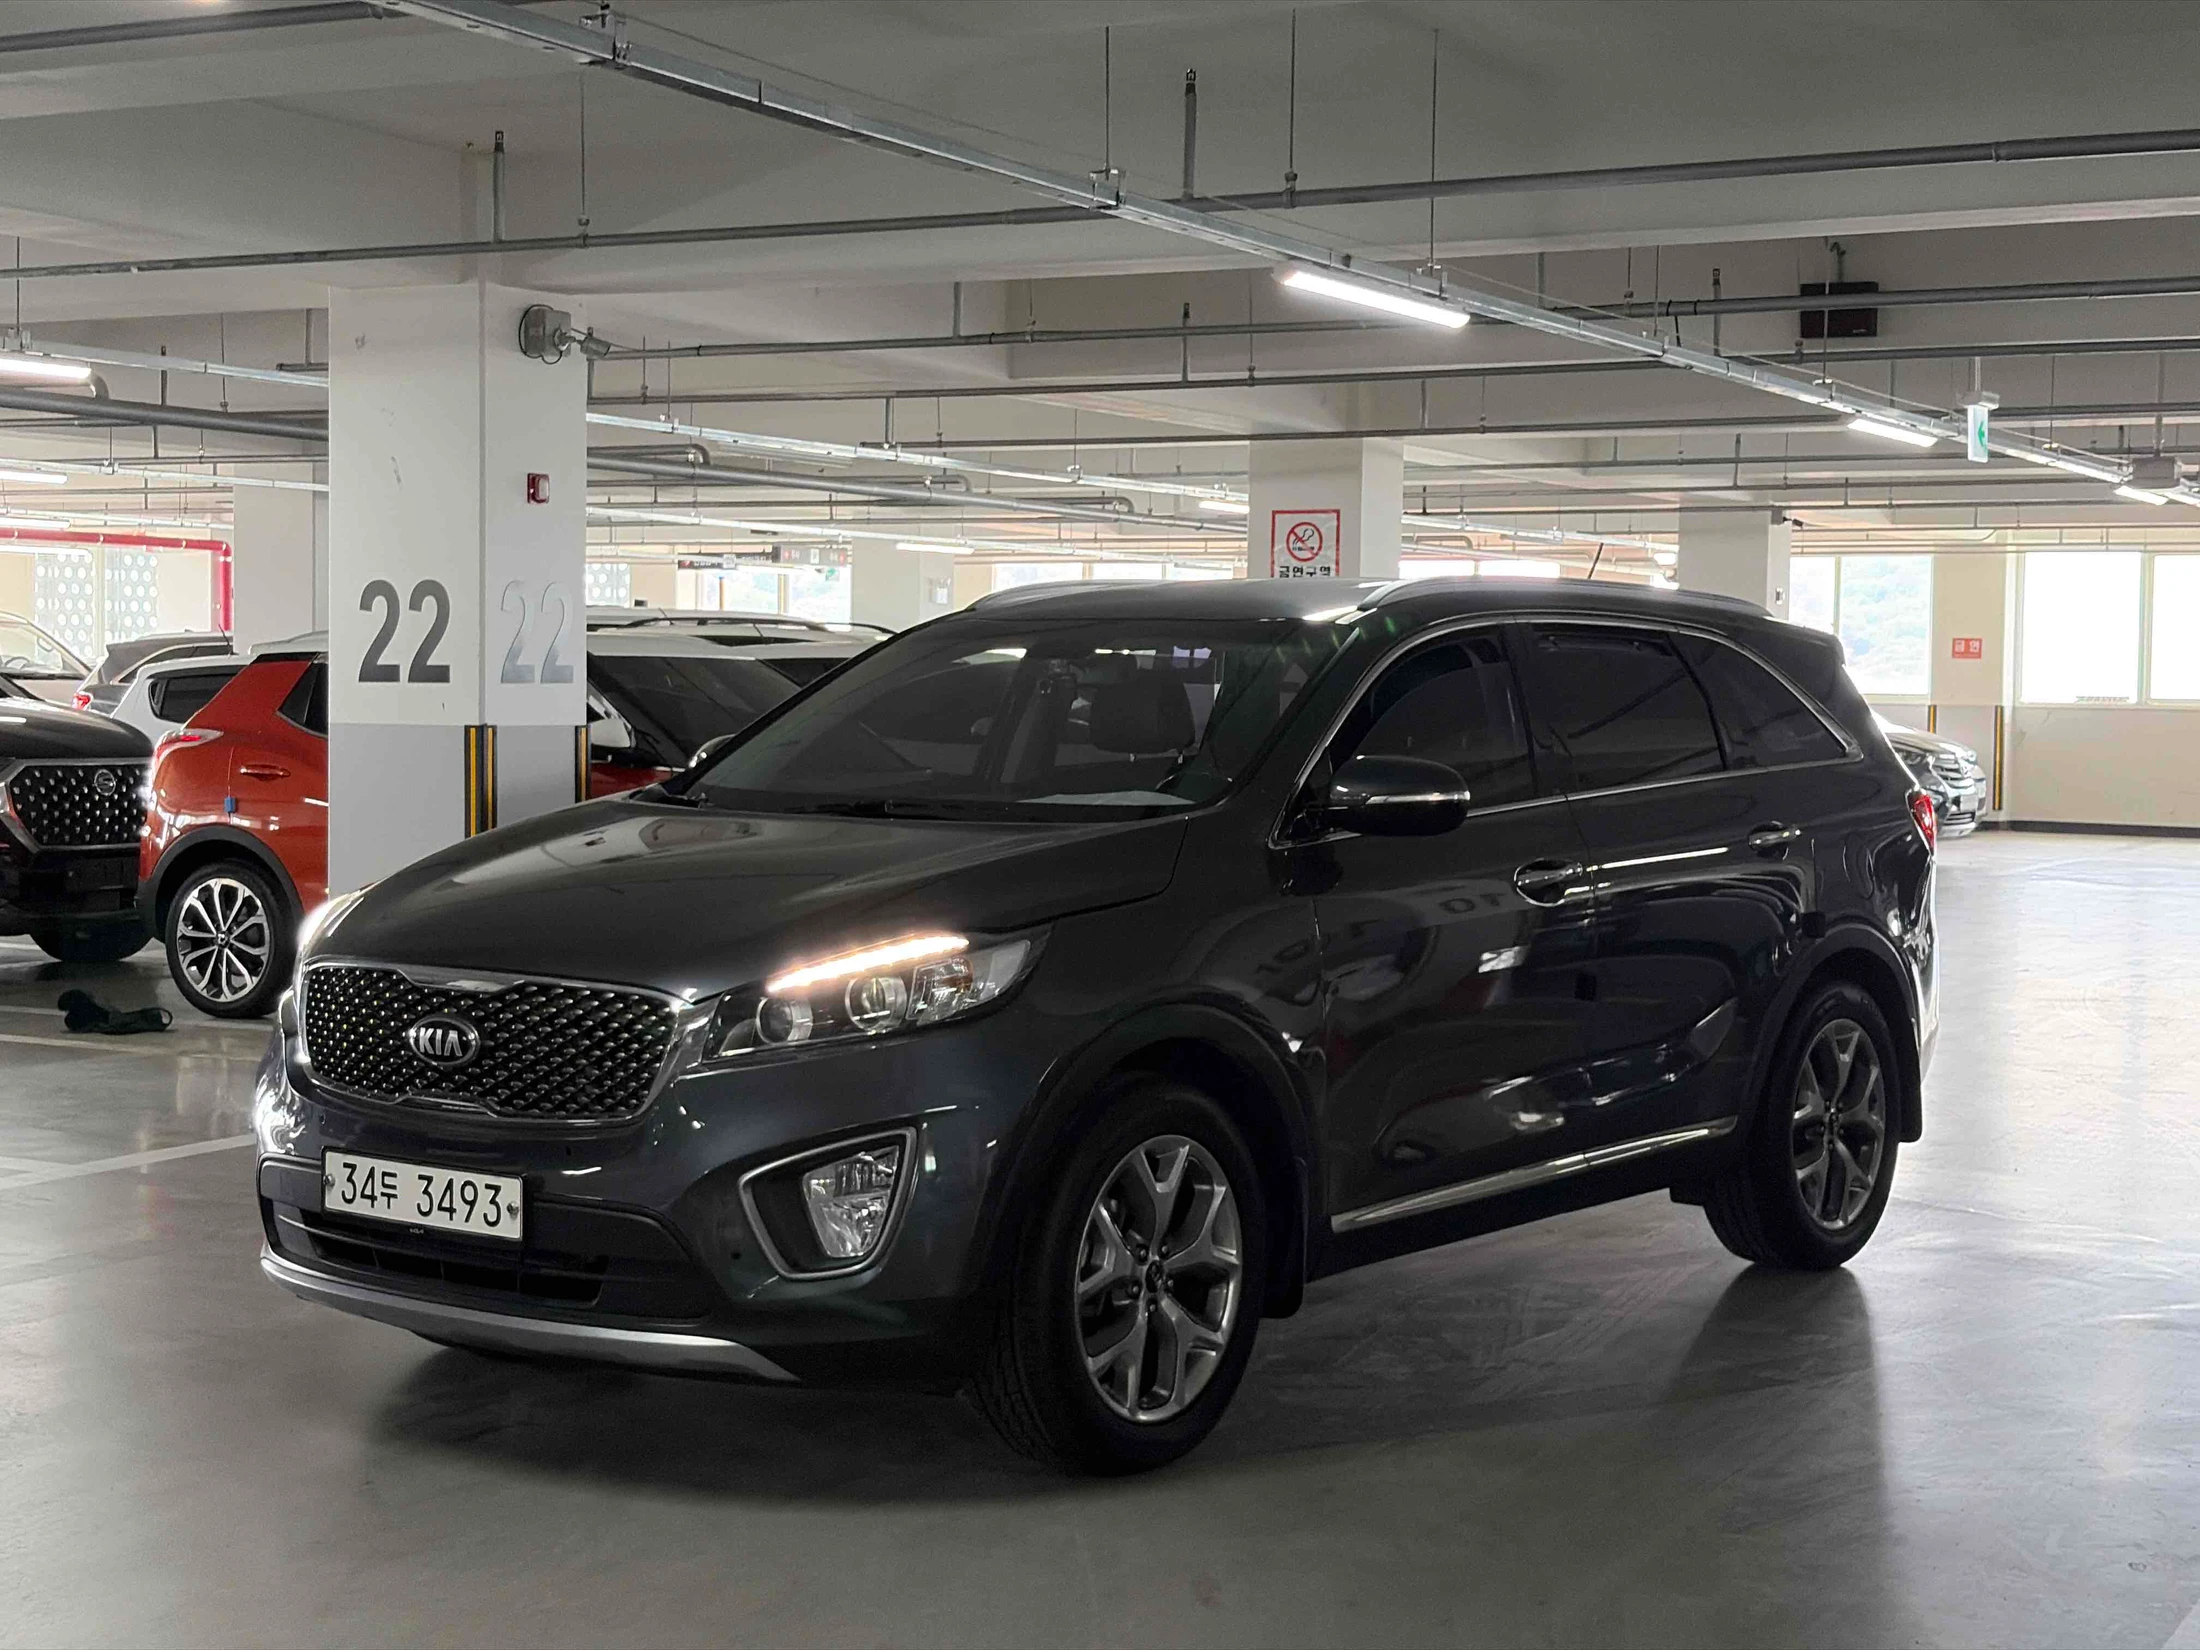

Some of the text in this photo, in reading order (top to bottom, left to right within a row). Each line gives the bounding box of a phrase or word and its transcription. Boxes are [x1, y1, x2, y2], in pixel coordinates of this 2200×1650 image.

[1278, 565, 1331, 578] 금연구역
[358, 579, 451, 683] 22
[500, 579, 574, 684] 22
[418, 1027, 463, 1057] KIA
[341, 1162, 503, 1228] 34두 3493
